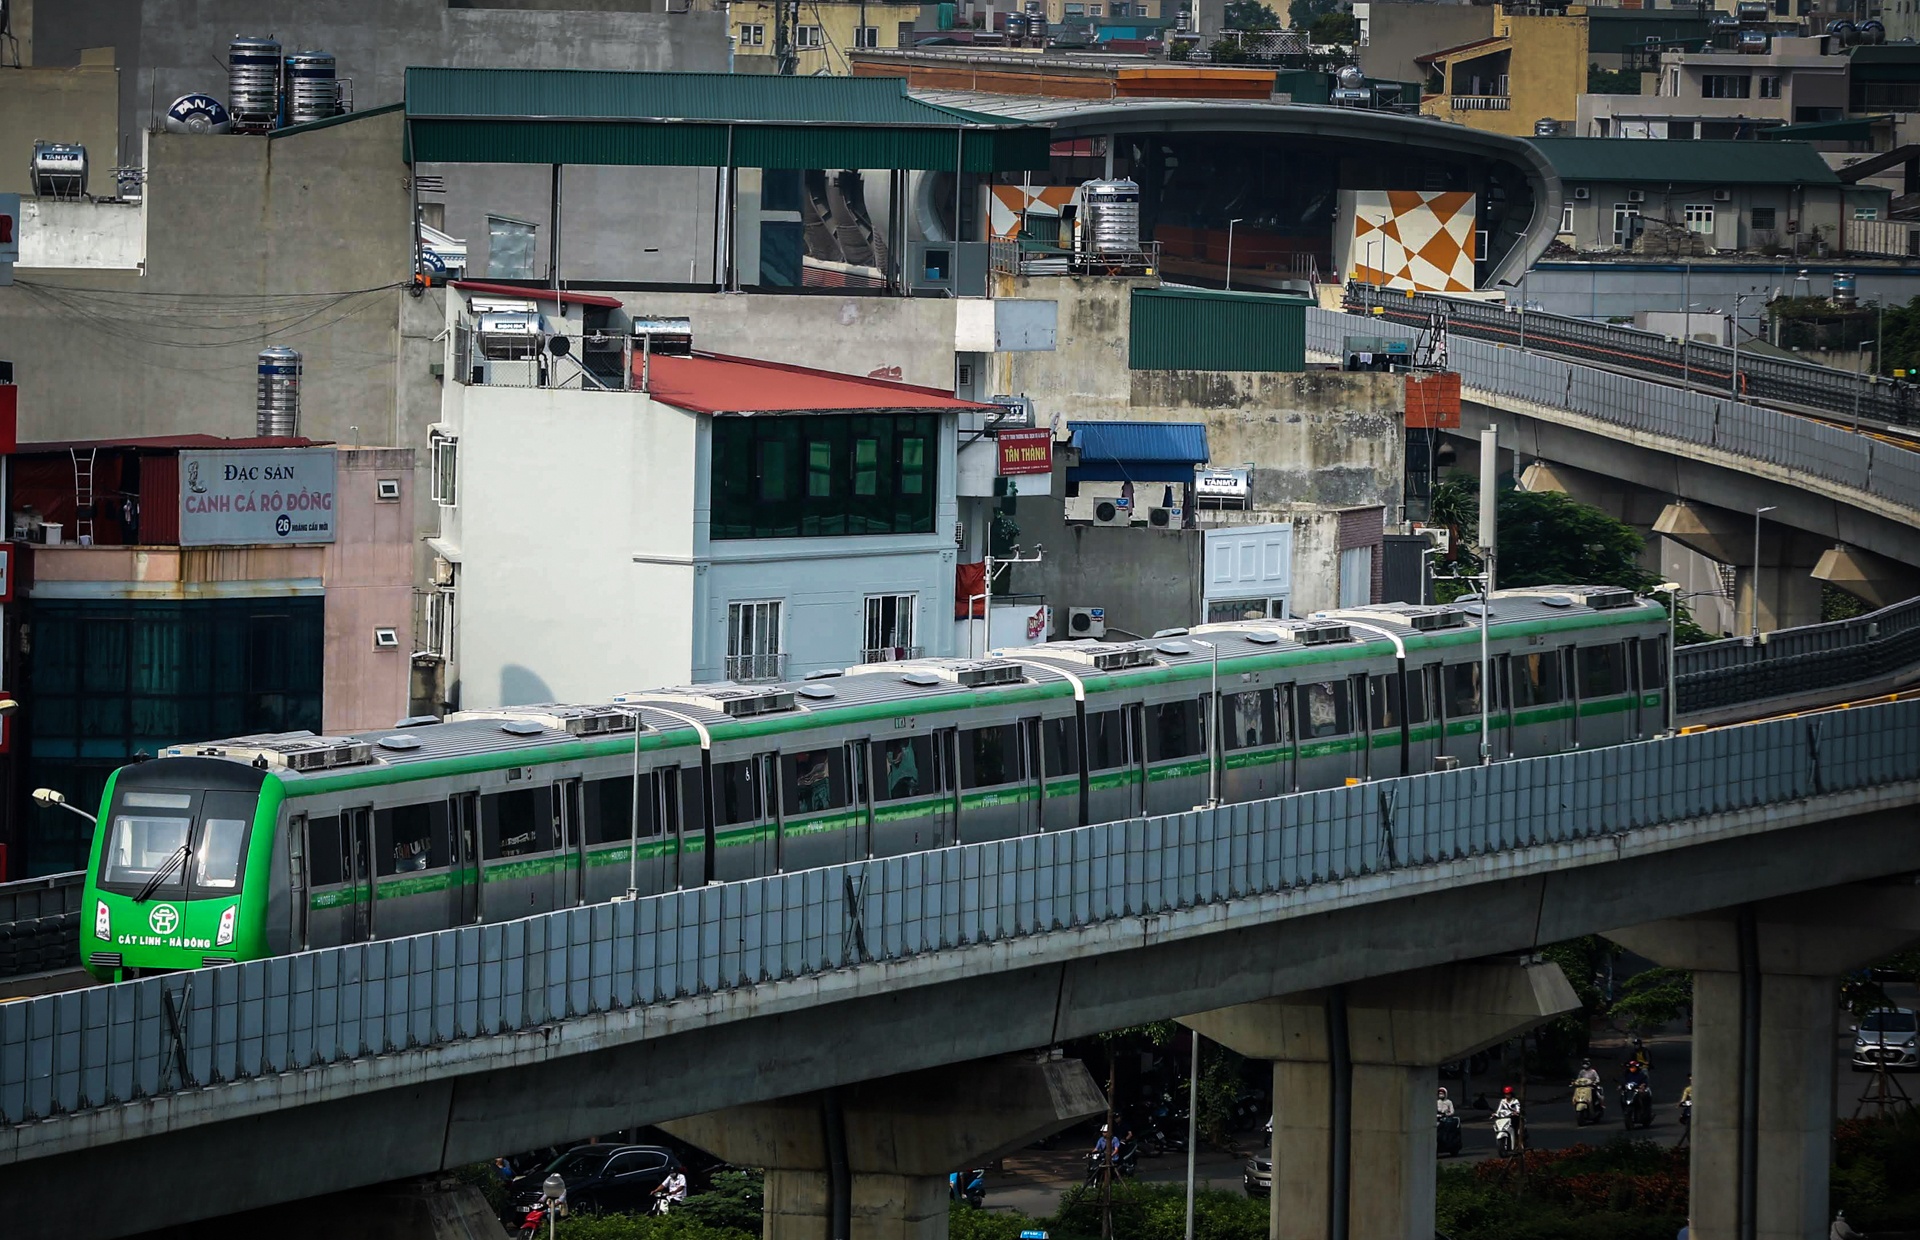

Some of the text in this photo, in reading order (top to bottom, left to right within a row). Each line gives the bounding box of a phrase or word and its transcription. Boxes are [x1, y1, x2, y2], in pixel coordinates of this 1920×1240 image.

[1004, 444, 1046, 462] TÂN THÀNH
[185, 494, 230, 513] CANH
[234, 490, 256, 512] CÁ
[260, 490, 283, 511] RÔ
[277, 519, 289, 532] 26
[118, 934, 137, 945] CÁT
[139, 936, 161, 946] LINH
[169, 936, 182, 947] HÀ
